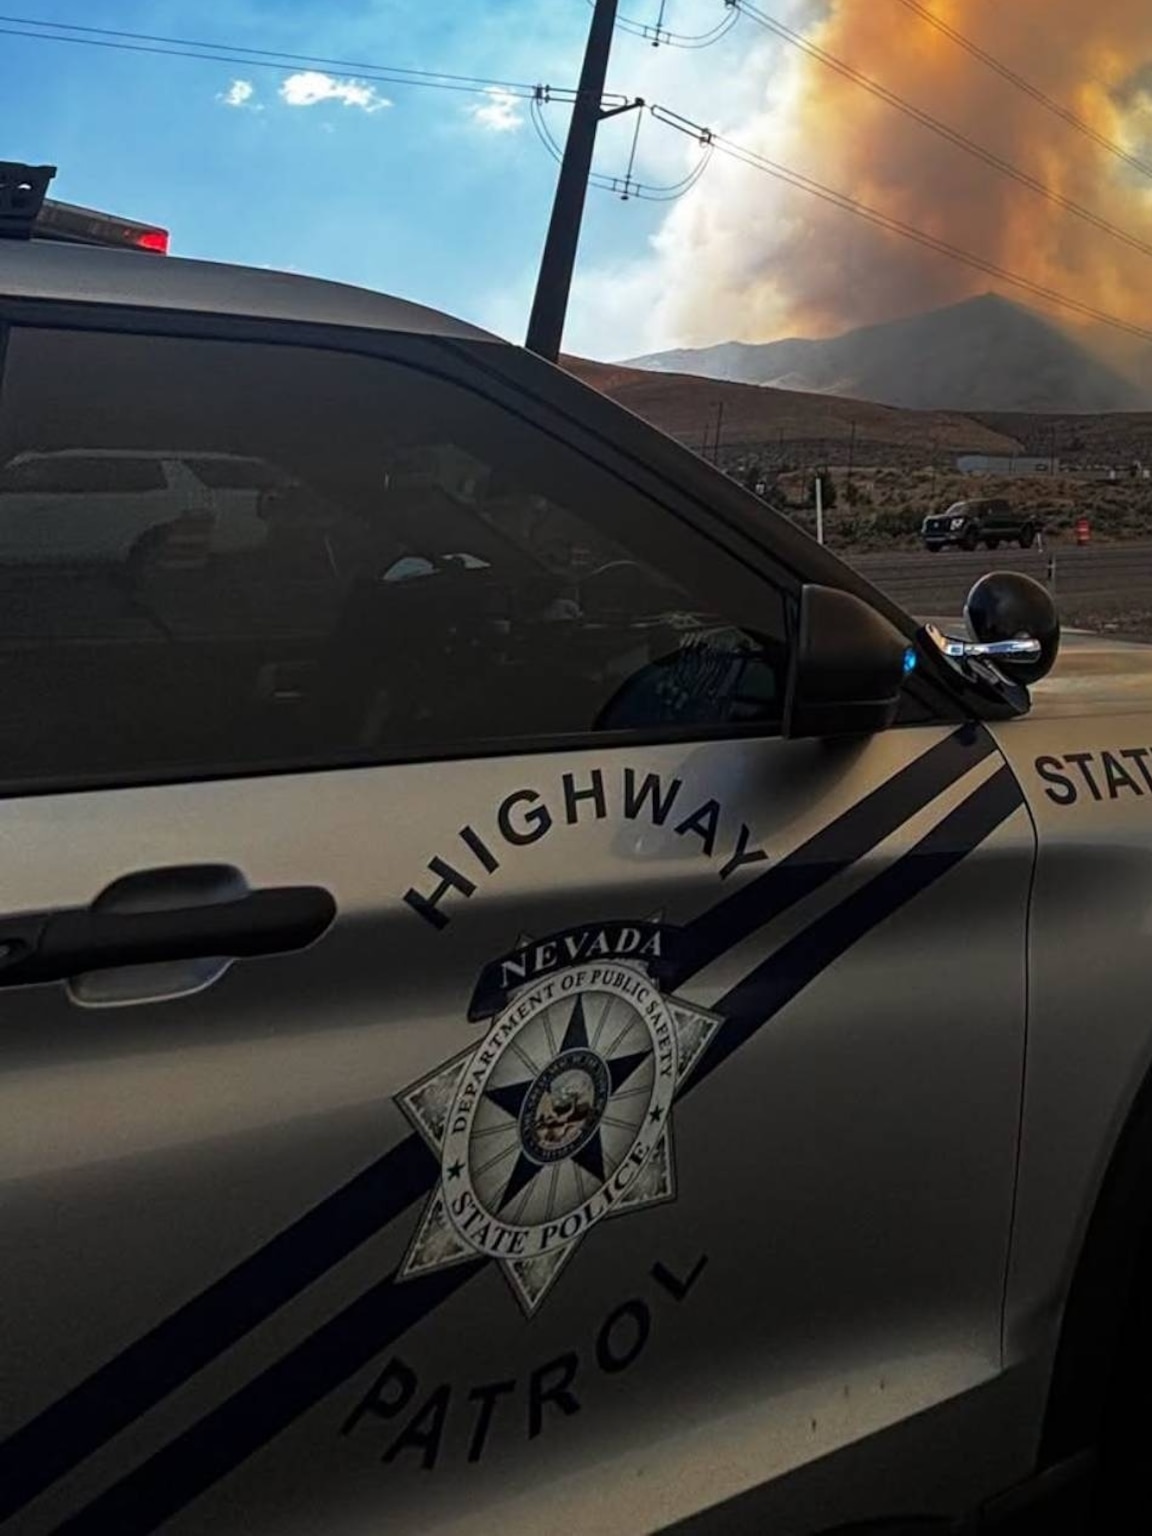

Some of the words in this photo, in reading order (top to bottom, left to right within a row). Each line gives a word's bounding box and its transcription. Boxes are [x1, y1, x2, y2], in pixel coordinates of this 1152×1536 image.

[402, 767, 768, 931] HIGHWAY
[499, 927, 662, 989] NEVADA
[452, 981, 559, 1135] DEPARTMENT
[561, 969, 587, 990] OF
[590, 968, 651, 1005] PUBLIC
[645, 1000, 673, 1078] SAFETY
[452, 1190, 529, 1255] STATE
[541, 1144, 651, 1249] POLICE
[339, 1253, 708, 1470] PATROL
